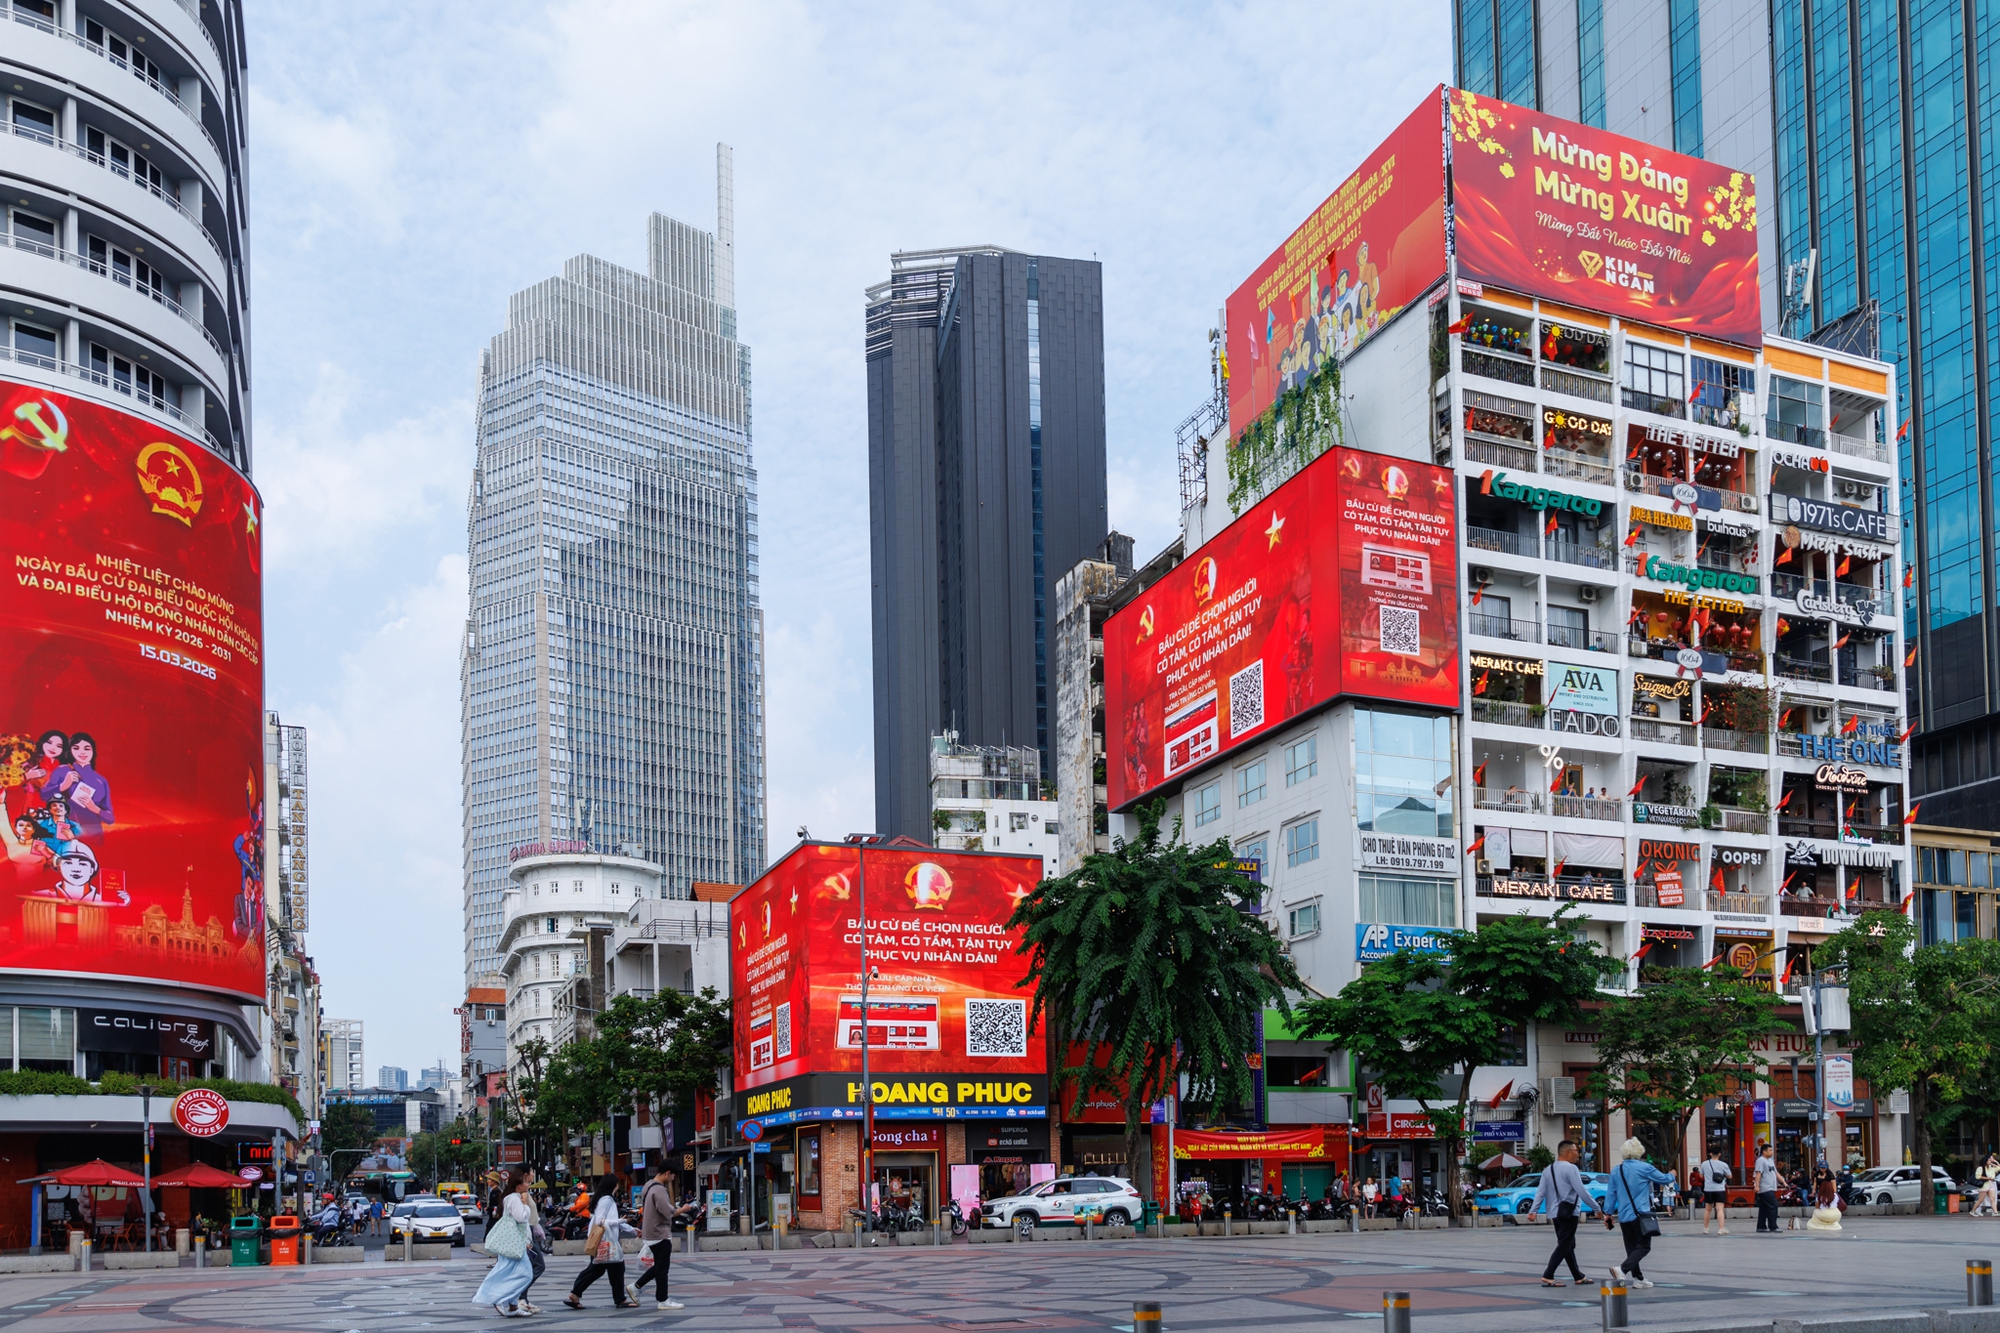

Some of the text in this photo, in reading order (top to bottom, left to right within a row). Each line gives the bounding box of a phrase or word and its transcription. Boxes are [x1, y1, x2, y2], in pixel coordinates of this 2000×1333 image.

[1381, 154, 1395, 177] XVI
[1532, 127, 1688, 203] Mừng Đảng
[1534, 166, 1690, 236] Mừng Xuân
[1535, 210, 1692, 264] Mừng Đất Nước Đổi Mới
[1605, 256, 1637, 275] KIM
[1606, 270, 1654, 293] NGAN
[1588, 330, 1610, 347] DAY
[1591, 421, 1612, 436] DAY
[1646, 422, 1740, 458] THE LETTER
[1676, 487, 1696, 500] 1664
[1344, 510, 1357, 520] CÓ
[1380, 516, 1392, 526] CÓ
[1433, 526, 1449, 538] TỤY
[1394, 508, 1417, 521] CHỌN
[1419, 513, 1445, 524] NGƯỜI
[1654, 510, 1693, 532] HEADSPA
[1706, 516, 1747, 538] buihaus
[1802, 502, 1885, 536] 1971's CAFE
[1355, 524, 1379, 536] PHỤC
[1380, 528, 1392, 539] VỤ
[16, 555, 233, 631] NGÀY BẦU CỬ ĐẠI BIỂU QUỐC HỘI
[96, 554, 234, 615] NHIỆT LIỆT CHÀO MỪNG
[17, 572, 39, 588] VÀ
[43, 578, 71, 595] ĐẠI
[76, 584, 112, 602] BIỂU
[115, 594, 141, 611] HỘI
[145, 601, 183, 624] ĐỒNG
[185, 616, 215, 637] NHÂN
[217, 630, 234, 648] DÂN
[1202, 599, 1226, 625] CHỌN
[1228, 578, 1257, 607] NGƯỜI
[1663, 589, 1744, 614] THE LETTER
[1796, 588, 1855, 619] Carlsberg
[106, 609, 232, 662] NHIỆM KỲ 2026 2031
[1157, 656, 1168, 674] CÓ
[1188, 634, 1200, 652] CÓ
[1223, 608, 1242, 630] TẬN
[1243, 595, 1262, 617] TỤY
[139, 643, 216, 680] 15.03.2026
[1166, 623, 1251, 687] PHỤC VỤ NHÂN DÂN!
[1470, 655, 1513, 671] MERAKI
[1562, 670, 1604, 692] AVA
[1634, 674, 1674, 698] Saigon
[1550, 710, 1620, 737] FADO
[1796, 734, 1900, 767] THE ONE
[1648, 806, 1697, 818] VEGETARIAN
[520, 840, 586, 857] SATRA GROUP
[1363, 836, 1376, 853] CHO
[1378, 835, 1396, 854] THUÊ
[1413, 839, 1436, 857] PHÒNG
[1437, 843, 1455, 859] 67m2
[1844, 835, 1872, 844] Heineken
[1376, 856, 1444, 870] LH: 0919.797.199
[1722, 851, 1761, 865] OOPS!
[1821, 848, 1892, 868] DOWNTOWN
[1493, 879, 1614, 900] MERAKI CAFÉ
[880, 918, 961, 935] CỬ ĐỂ CHỌN
[1669, 930, 1695, 939] PIZZA
[866, 933, 898, 946] TÂM,
[901, 934, 920, 946] CÓ
[957, 936, 984, 950] TẬN
[987, 940, 1012, 951] TỤY
[901, 950, 997, 963] VỤ NHÂN DÂN!
[462, 1016, 470, 1053] HOTEL
[179, 1091, 227, 1111] HIGHLANDS
[748, 1087, 791, 1115] HOANG PHUC
[847, 1082, 1032, 1103] HOANG PHUC
[185, 1123, 221, 1135] COFFEE
[905, 1130, 928, 1141] cha
